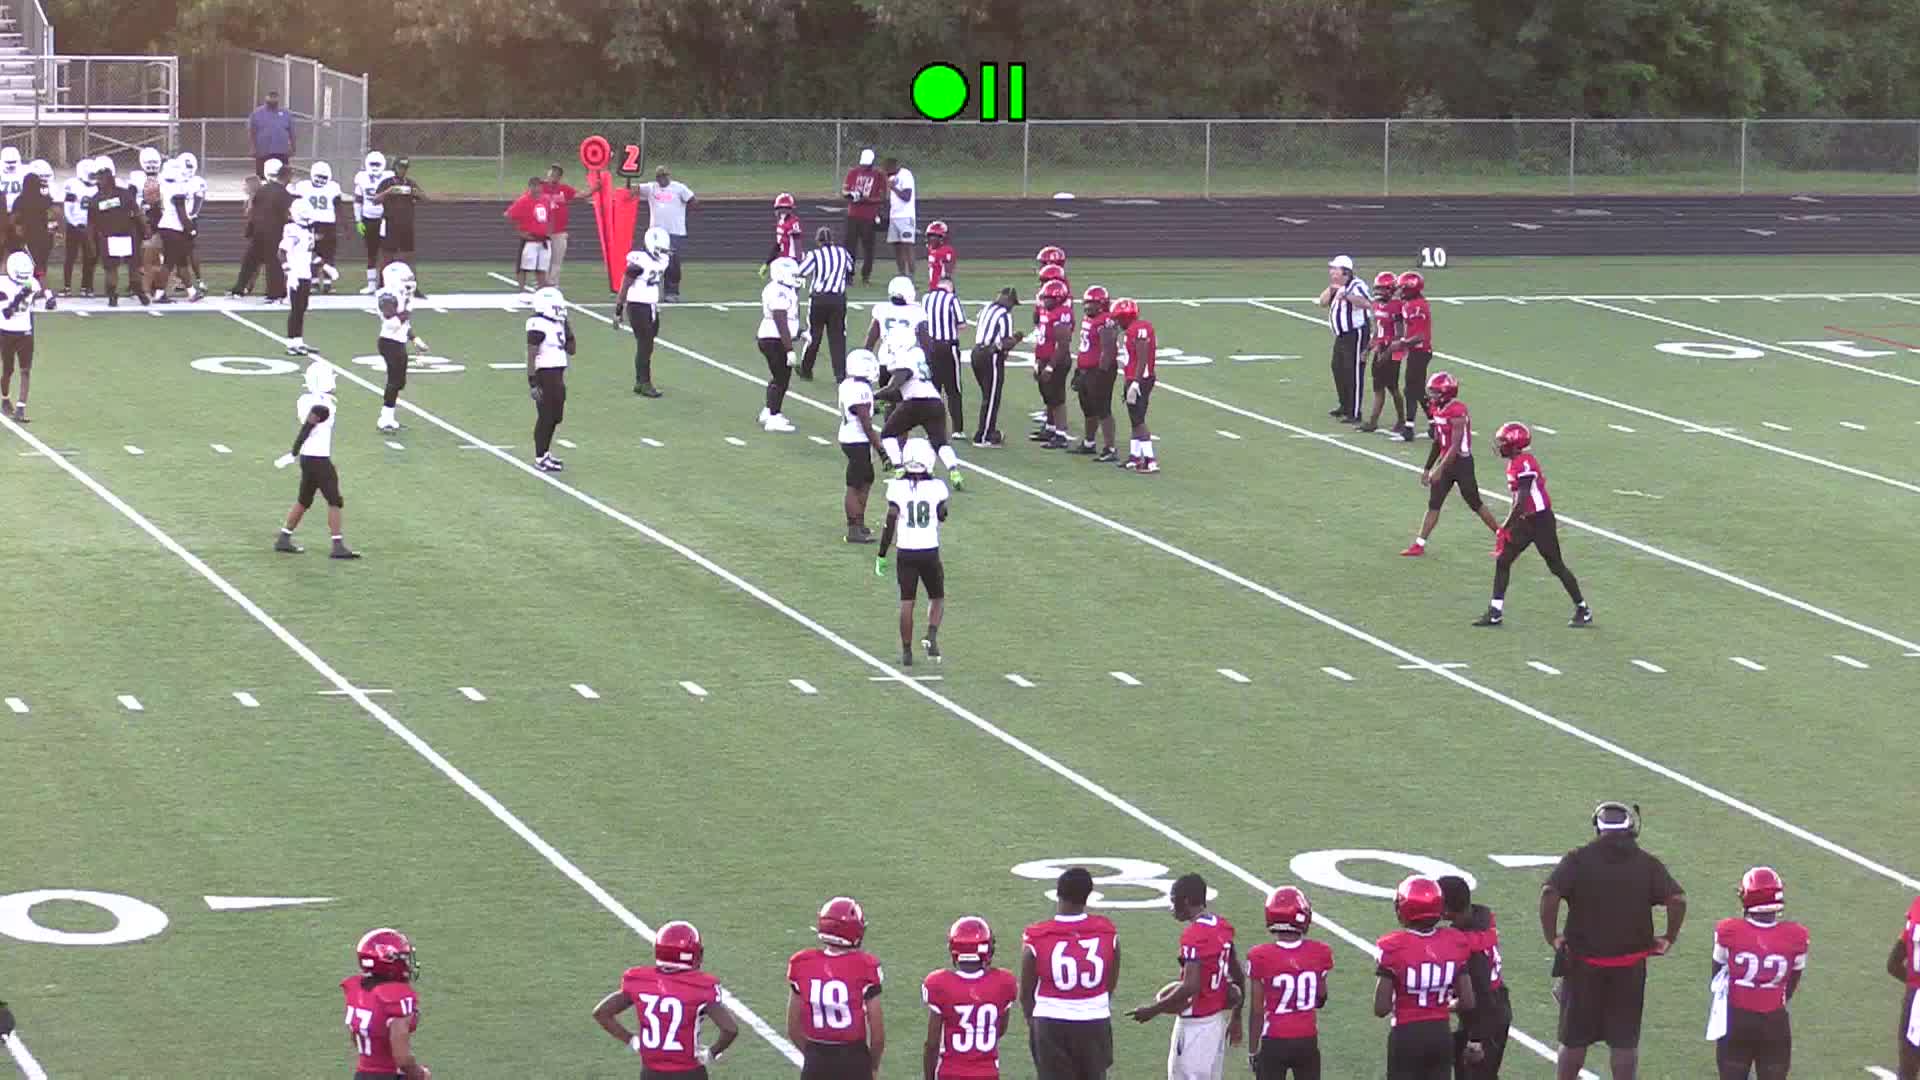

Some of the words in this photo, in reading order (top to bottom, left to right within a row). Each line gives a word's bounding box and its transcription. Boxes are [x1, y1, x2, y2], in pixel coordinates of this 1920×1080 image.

[622, 145, 641, 171] 2
[1421, 247, 1447, 267] 10
[906, 501, 930, 529] 18
[1051, 937, 1104, 991] 63
[1406, 961, 1455, 1008] 44
[1734, 951, 1788, 989] 22
[810, 979, 853, 1029] 18
[1272, 971, 1318, 1014] 20
[639, 993, 684, 1051] 32
[952, 1004, 998, 1053] 30
